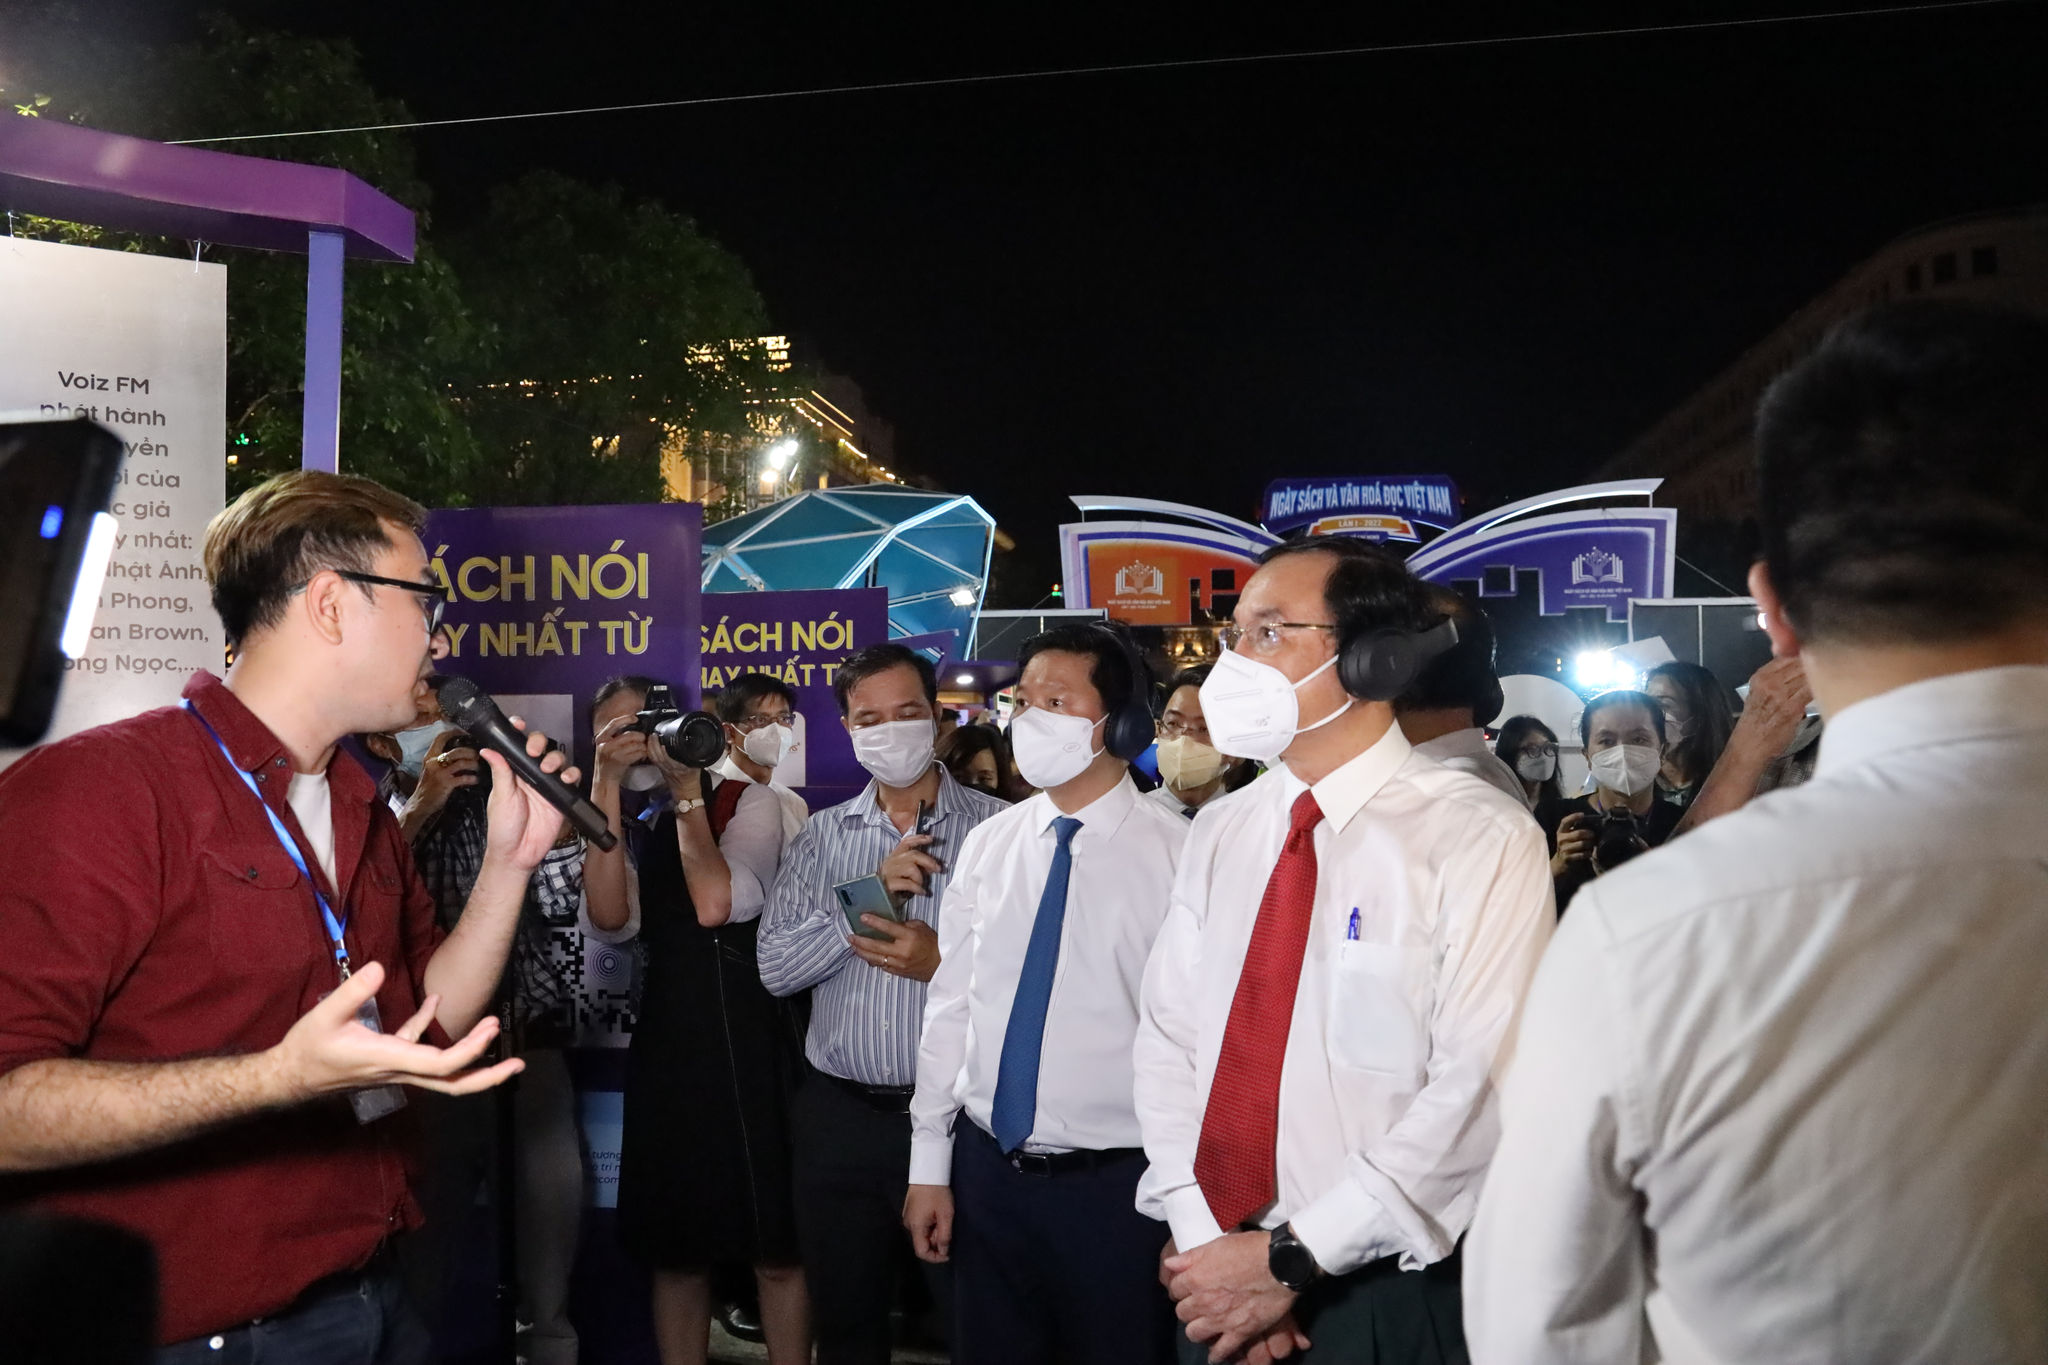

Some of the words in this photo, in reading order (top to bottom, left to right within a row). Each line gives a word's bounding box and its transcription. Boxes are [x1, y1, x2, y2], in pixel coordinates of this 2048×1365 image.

[58, 371, 109, 391] Voiz
[116, 376, 149, 394] FM
[105, 406, 166, 426] hành
[124, 437, 168, 458] yền
[136, 469, 180, 488] của
[133, 500, 171, 520] giả
[1269, 486, 1298, 521] NGÀY
[1297, 484, 1324, 513] SÁCH
[1325, 482, 1339, 509] VÀ
[1339, 482, 1360, 507] VĂN
[1382, 485, 1404, 512] ĐỌC
[1403, 480, 1426, 516] VIỆT
[1426, 485, 1452, 516] NAM
[134, 530, 193, 549] nhất:
[430, 544, 536, 602] ÁCH
[551, 540, 649, 601] NÓI
[111, 592, 193, 613] Phong,
[91, 626, 121, 639] an
[128, 624, 209, 642] Brown,
[480, 607, 589, 657] NHẤT
[599, 611, 653, 655] TỪ
[791, 611, 854, 651] NÓI
